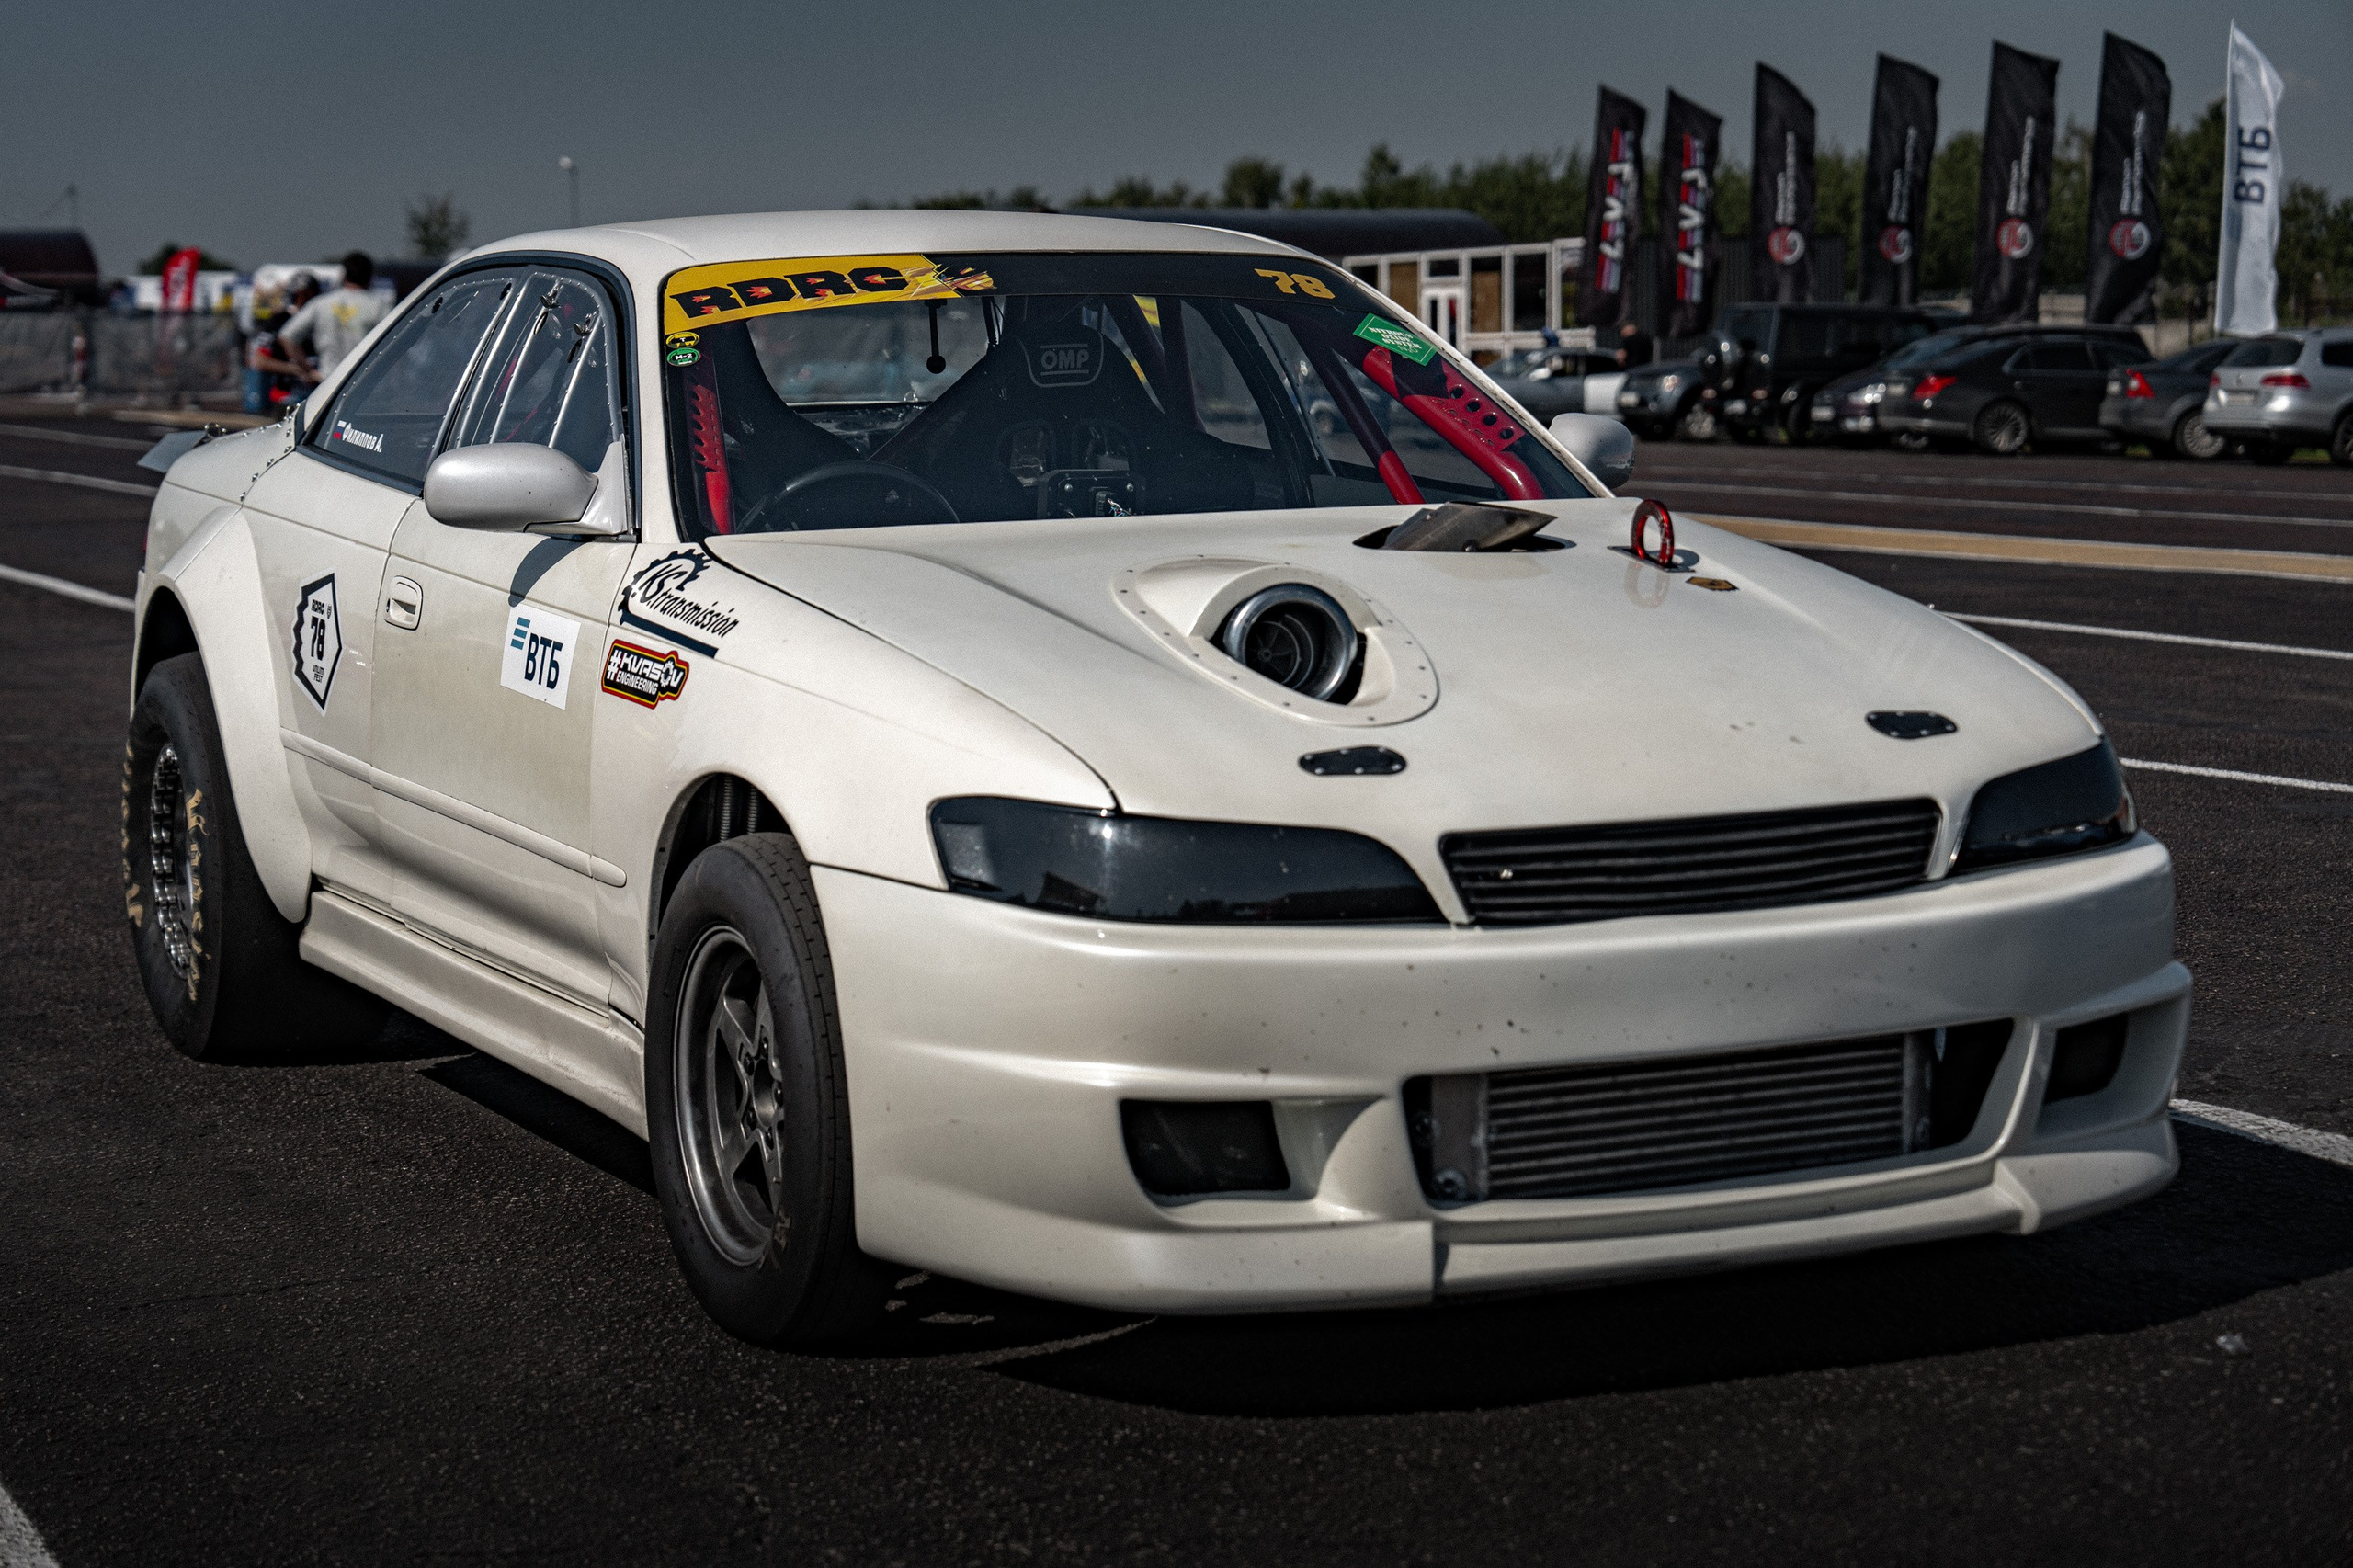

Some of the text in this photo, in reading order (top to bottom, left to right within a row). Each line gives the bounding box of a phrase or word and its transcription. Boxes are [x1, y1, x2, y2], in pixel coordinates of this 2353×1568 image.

[2234, 127, 2271, 204] ВТБ
[669, 267, 909, 319] RDRC
[1255, 268, 1335, 299] 78
[1040, 348, 1090, 369] OMP
[311, 615, 325, 661] 78
[524, 632, 563, 690] ВТБ
